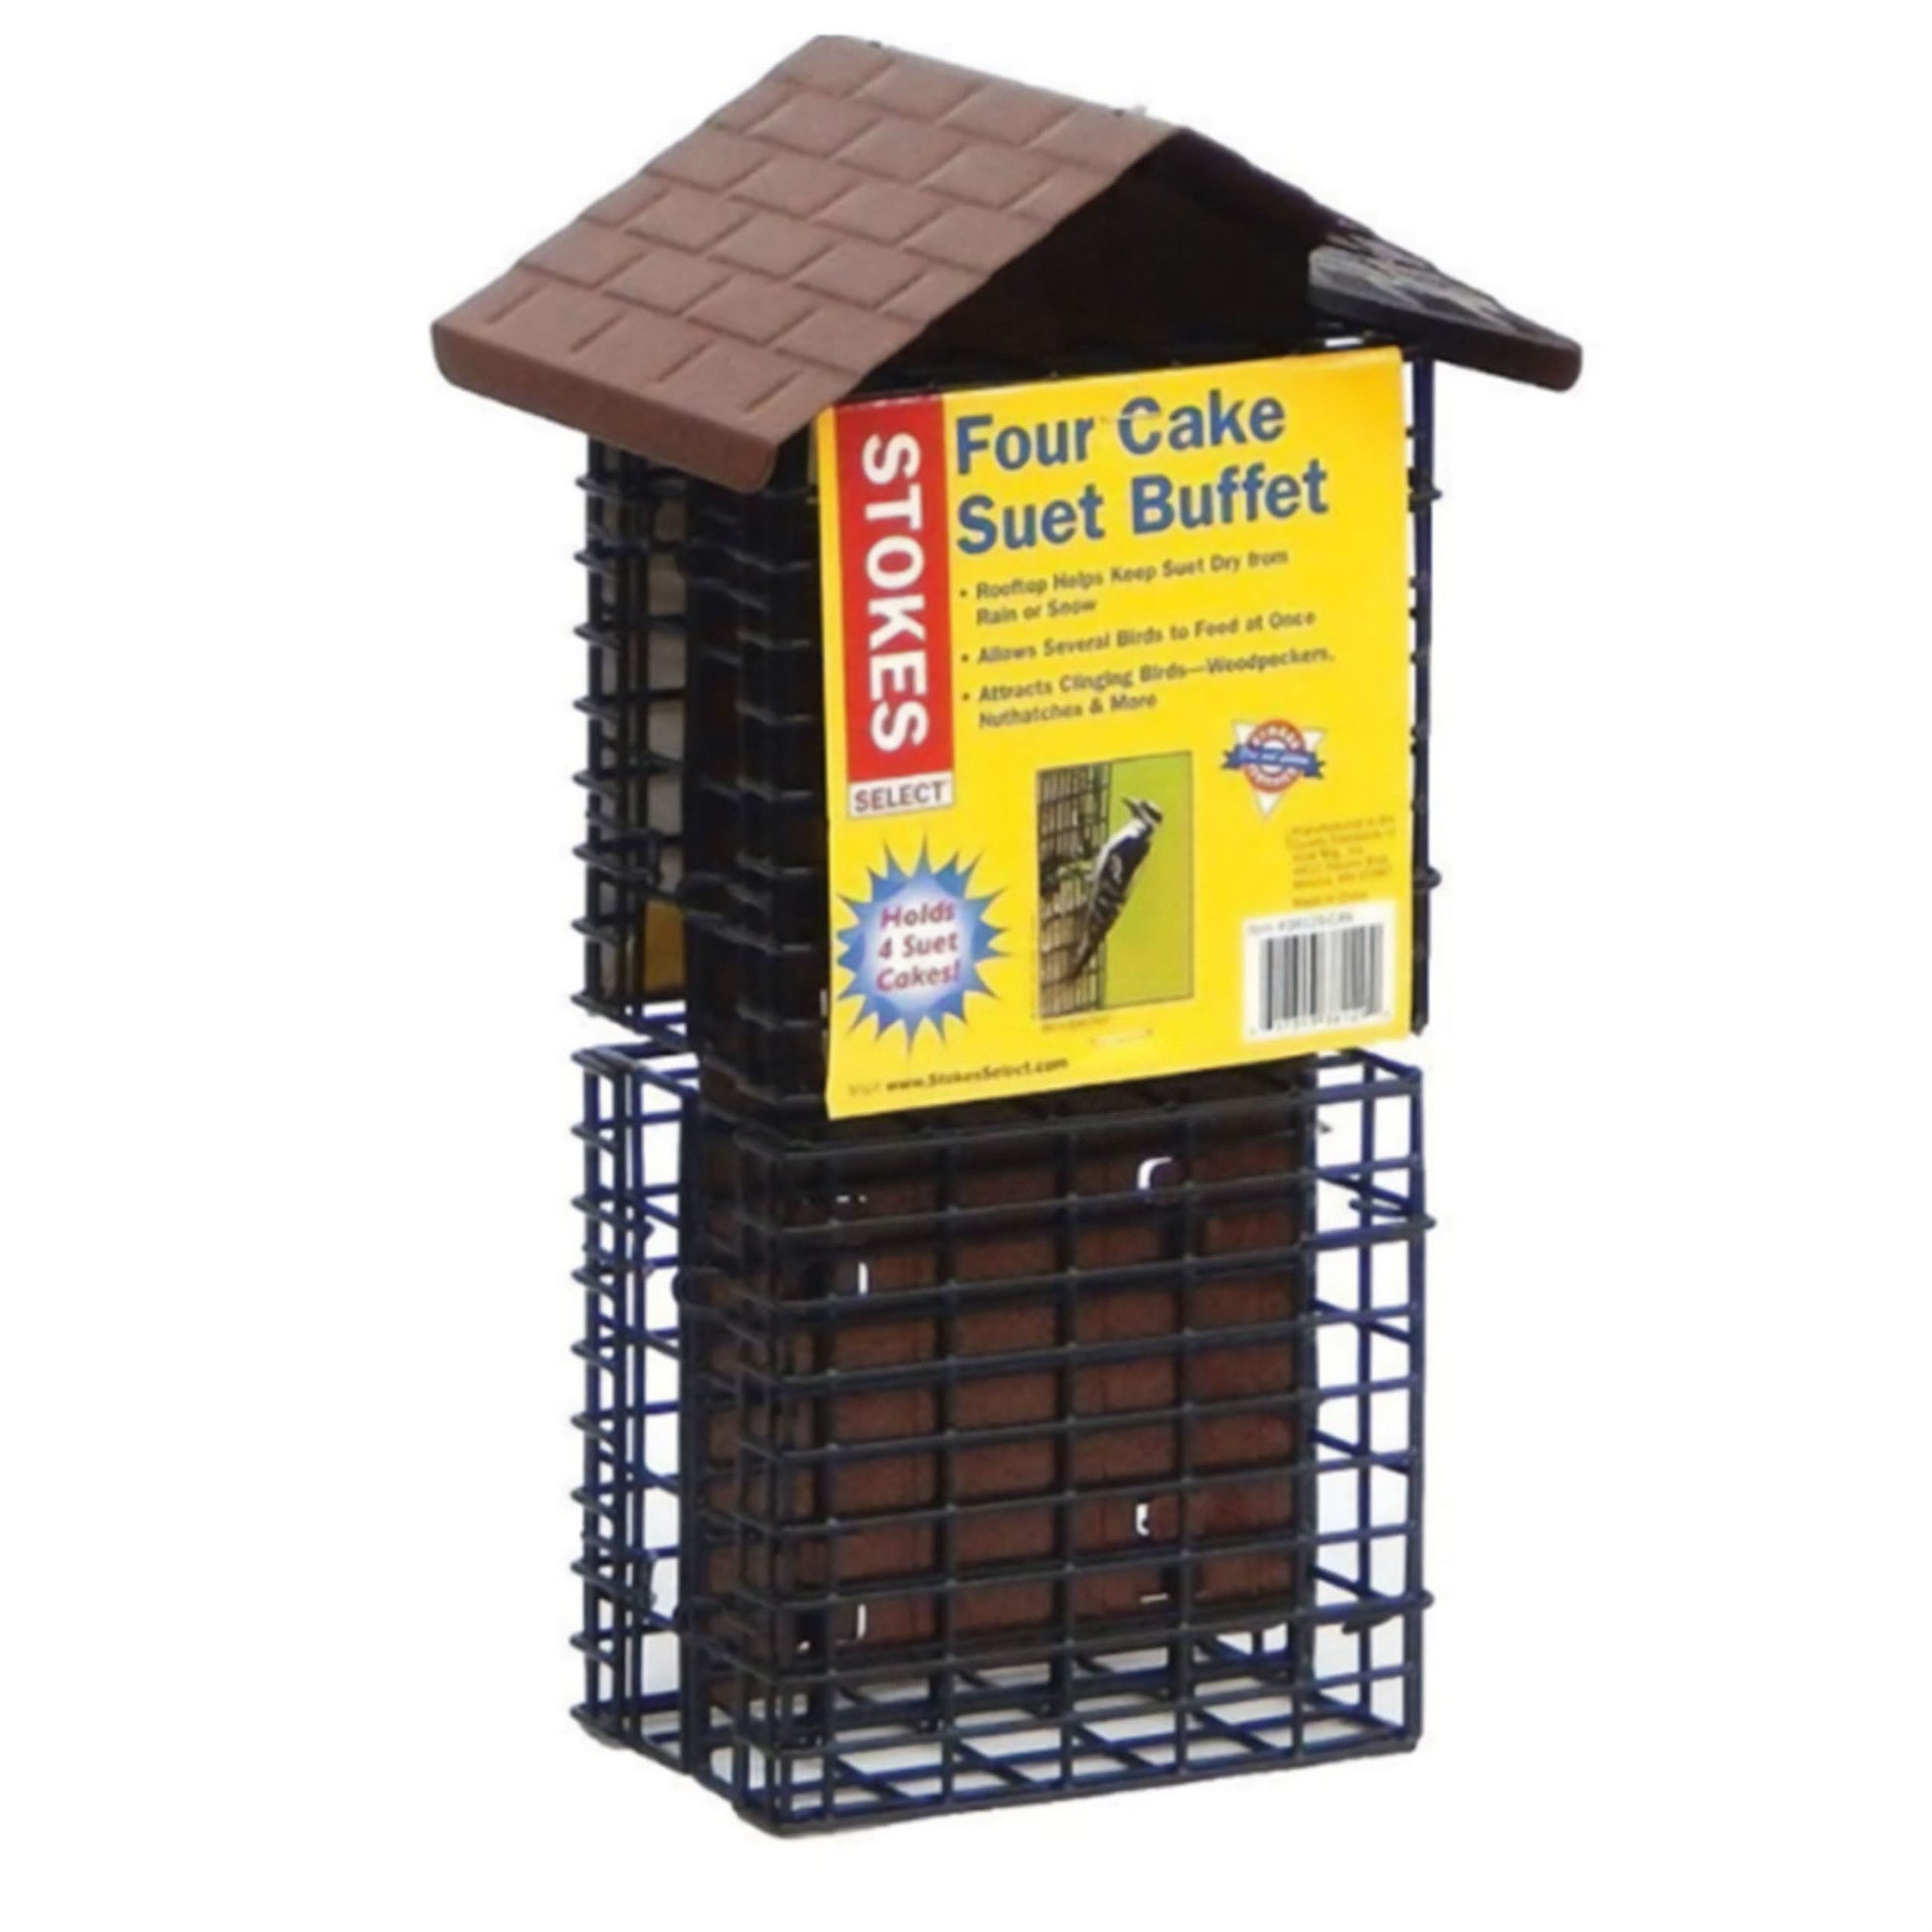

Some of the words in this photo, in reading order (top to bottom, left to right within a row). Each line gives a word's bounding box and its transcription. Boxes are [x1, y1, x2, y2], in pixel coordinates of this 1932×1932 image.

[955, 413, 1095, 477] Four
[1117, 388, 1286, 456] Cake
[956, 483, 1105, 555] Suet
[1131, 458, 1329, 535] Buffet
[976, 578, 1048, 600] Rooftop
[1052, 570, 1104, 591] Helps
[1110, 564, 1158, 583] Keep
[1162, 557, 1205, 578] Suet
[1209, 553, 1241, 573] Dry
[1247, 550, 1290, 568] from
[862, 433, 929, 754] STOKES
[976, 607, 1019, 626] Rain
[1022, 606, 1041, 621] or
[1046, 599, 1097, 618] Snow
[978, 645, 1037, 664] Allows
[1042, 631, 1111, 657] Several
[1116, 625, 1164, 647] Birds
[1170, 623, 1189, 640] to
[1193, 618, 1240, 638] Feed
[1245, 614, 1264, 632] at
[1268, 611, 1316, 630] Once
[978, 679, 1053, 703] Attracts
[1058, 669, 1134, 692] Clinging
[978, 702, 1083, 729] Nuthatches
[1089, 696, 1104, 715] &
[1110, 693, 1158, 711] More
[854, 780, 946, 813] SELECT
[879, 899, 957, 930] Holds
[878, 937, 894, 960] 4
[901, 931, 959, 959] Suet
[875, 959, 963, 994] Cakes!
[886, 1057, 1070, 1092] www.StokesSelect.com
